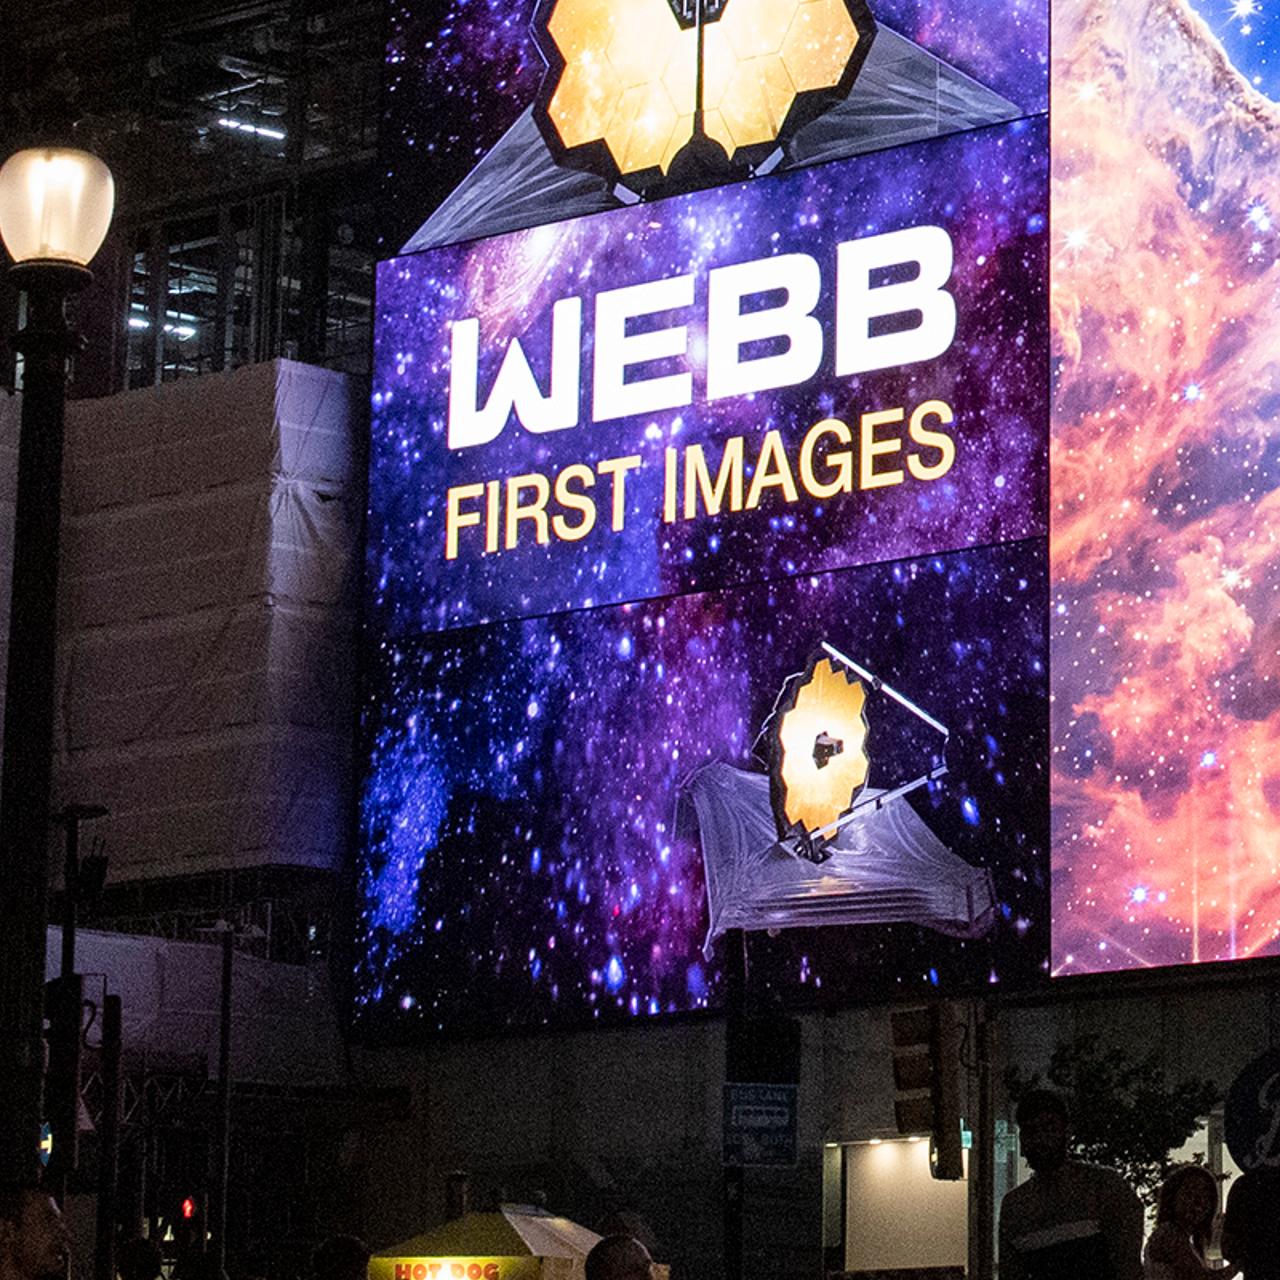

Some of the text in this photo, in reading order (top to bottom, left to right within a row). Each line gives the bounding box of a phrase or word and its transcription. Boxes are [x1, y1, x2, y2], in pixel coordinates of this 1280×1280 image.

[447, 224, 957, 450] WEBB
[445, 399, 956, 561] FIRST IMAGES
[395, 1263, 442, 1280] HOT
